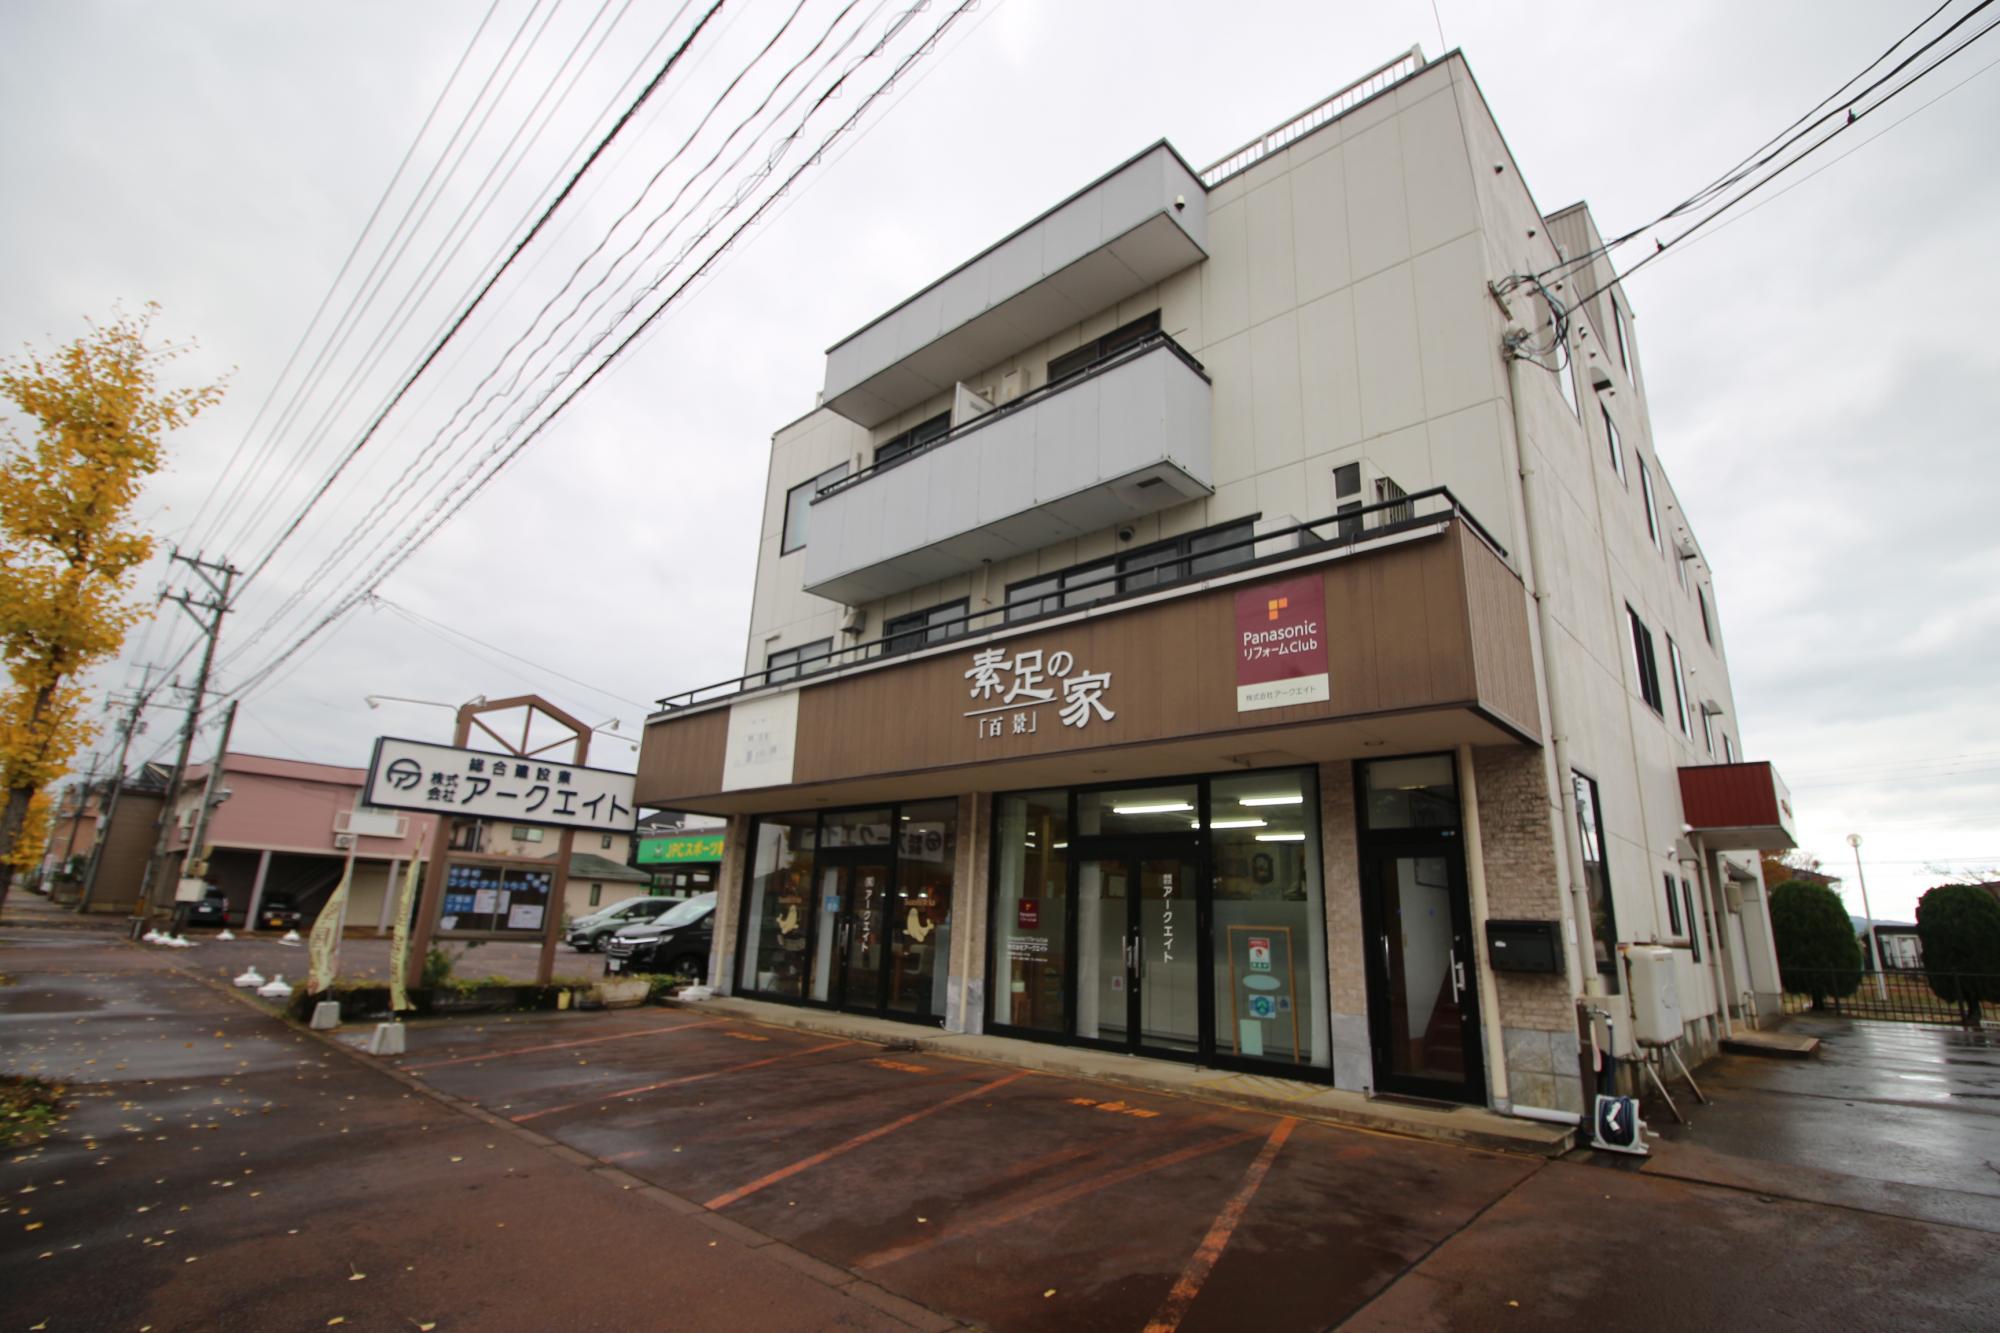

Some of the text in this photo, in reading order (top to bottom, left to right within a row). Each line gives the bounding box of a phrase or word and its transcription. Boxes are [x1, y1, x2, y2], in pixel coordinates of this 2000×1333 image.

[1243, 620, 1317, 646] Panasonic
[1243, 638, 1318, 661] リフォームClub
[964, 648, 1116, 729] 素足の家
[461, 776, 630, 822] アークエイト
